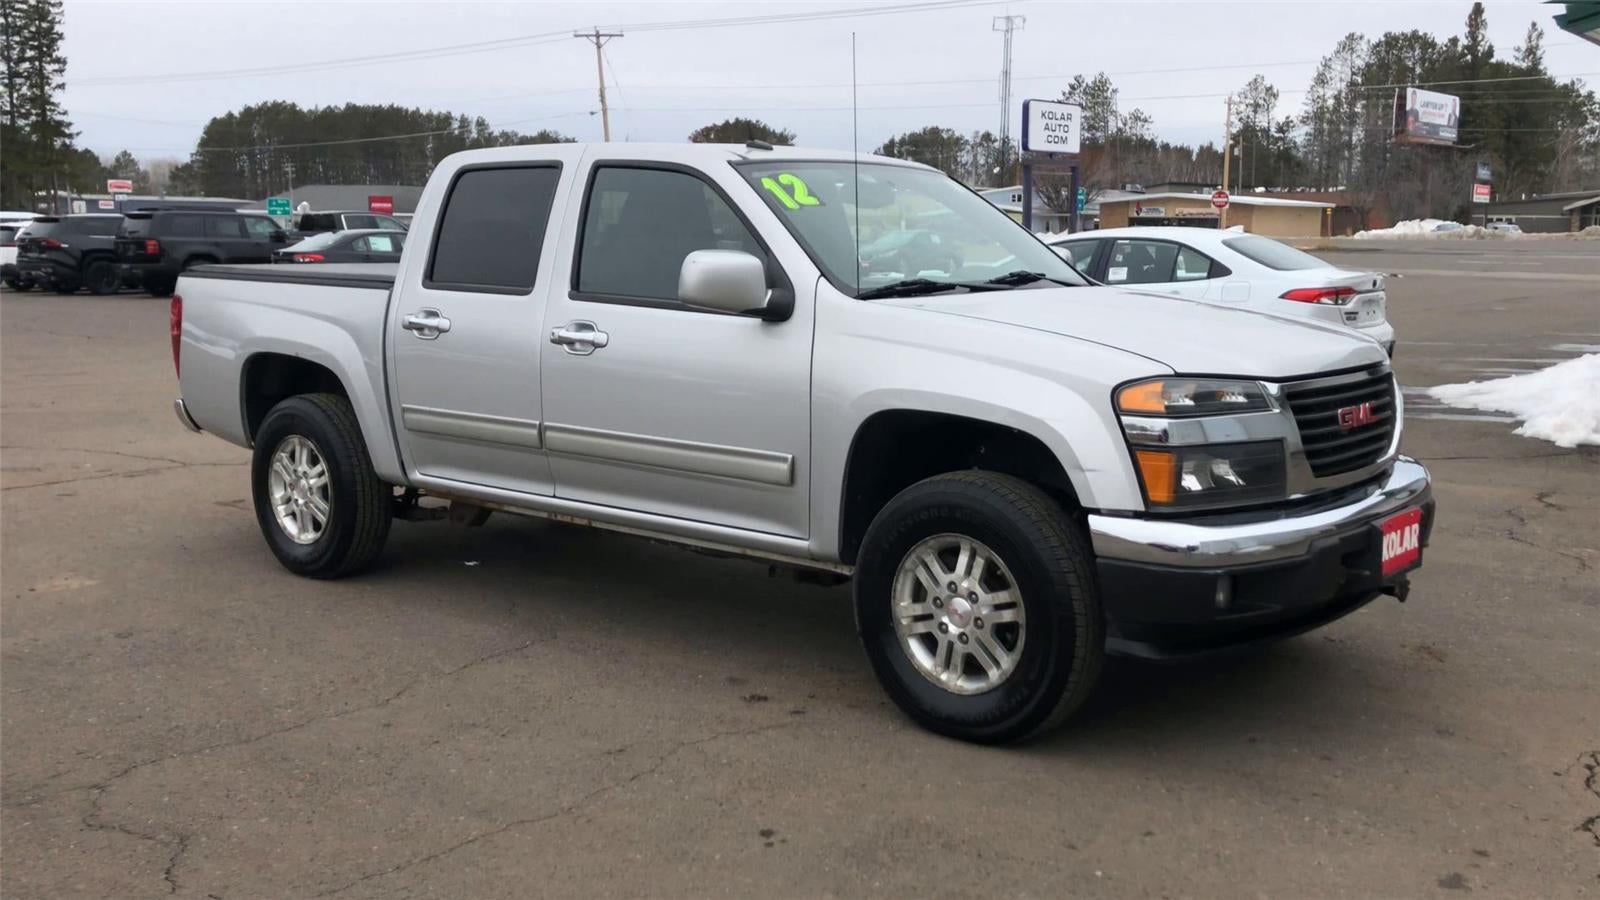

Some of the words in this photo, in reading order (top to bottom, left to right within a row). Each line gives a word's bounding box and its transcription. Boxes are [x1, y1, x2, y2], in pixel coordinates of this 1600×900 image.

[1041, 110, 1072, 122] KOLAR
[1044, 123, 1069, 133] AUTO
[1044, 135, 1068, 144] .COM
[760, 173, 819, 209] 12
[1338, 401, 1379, 428] GMC
[1382, 523, 1419, 562] KOLAR
